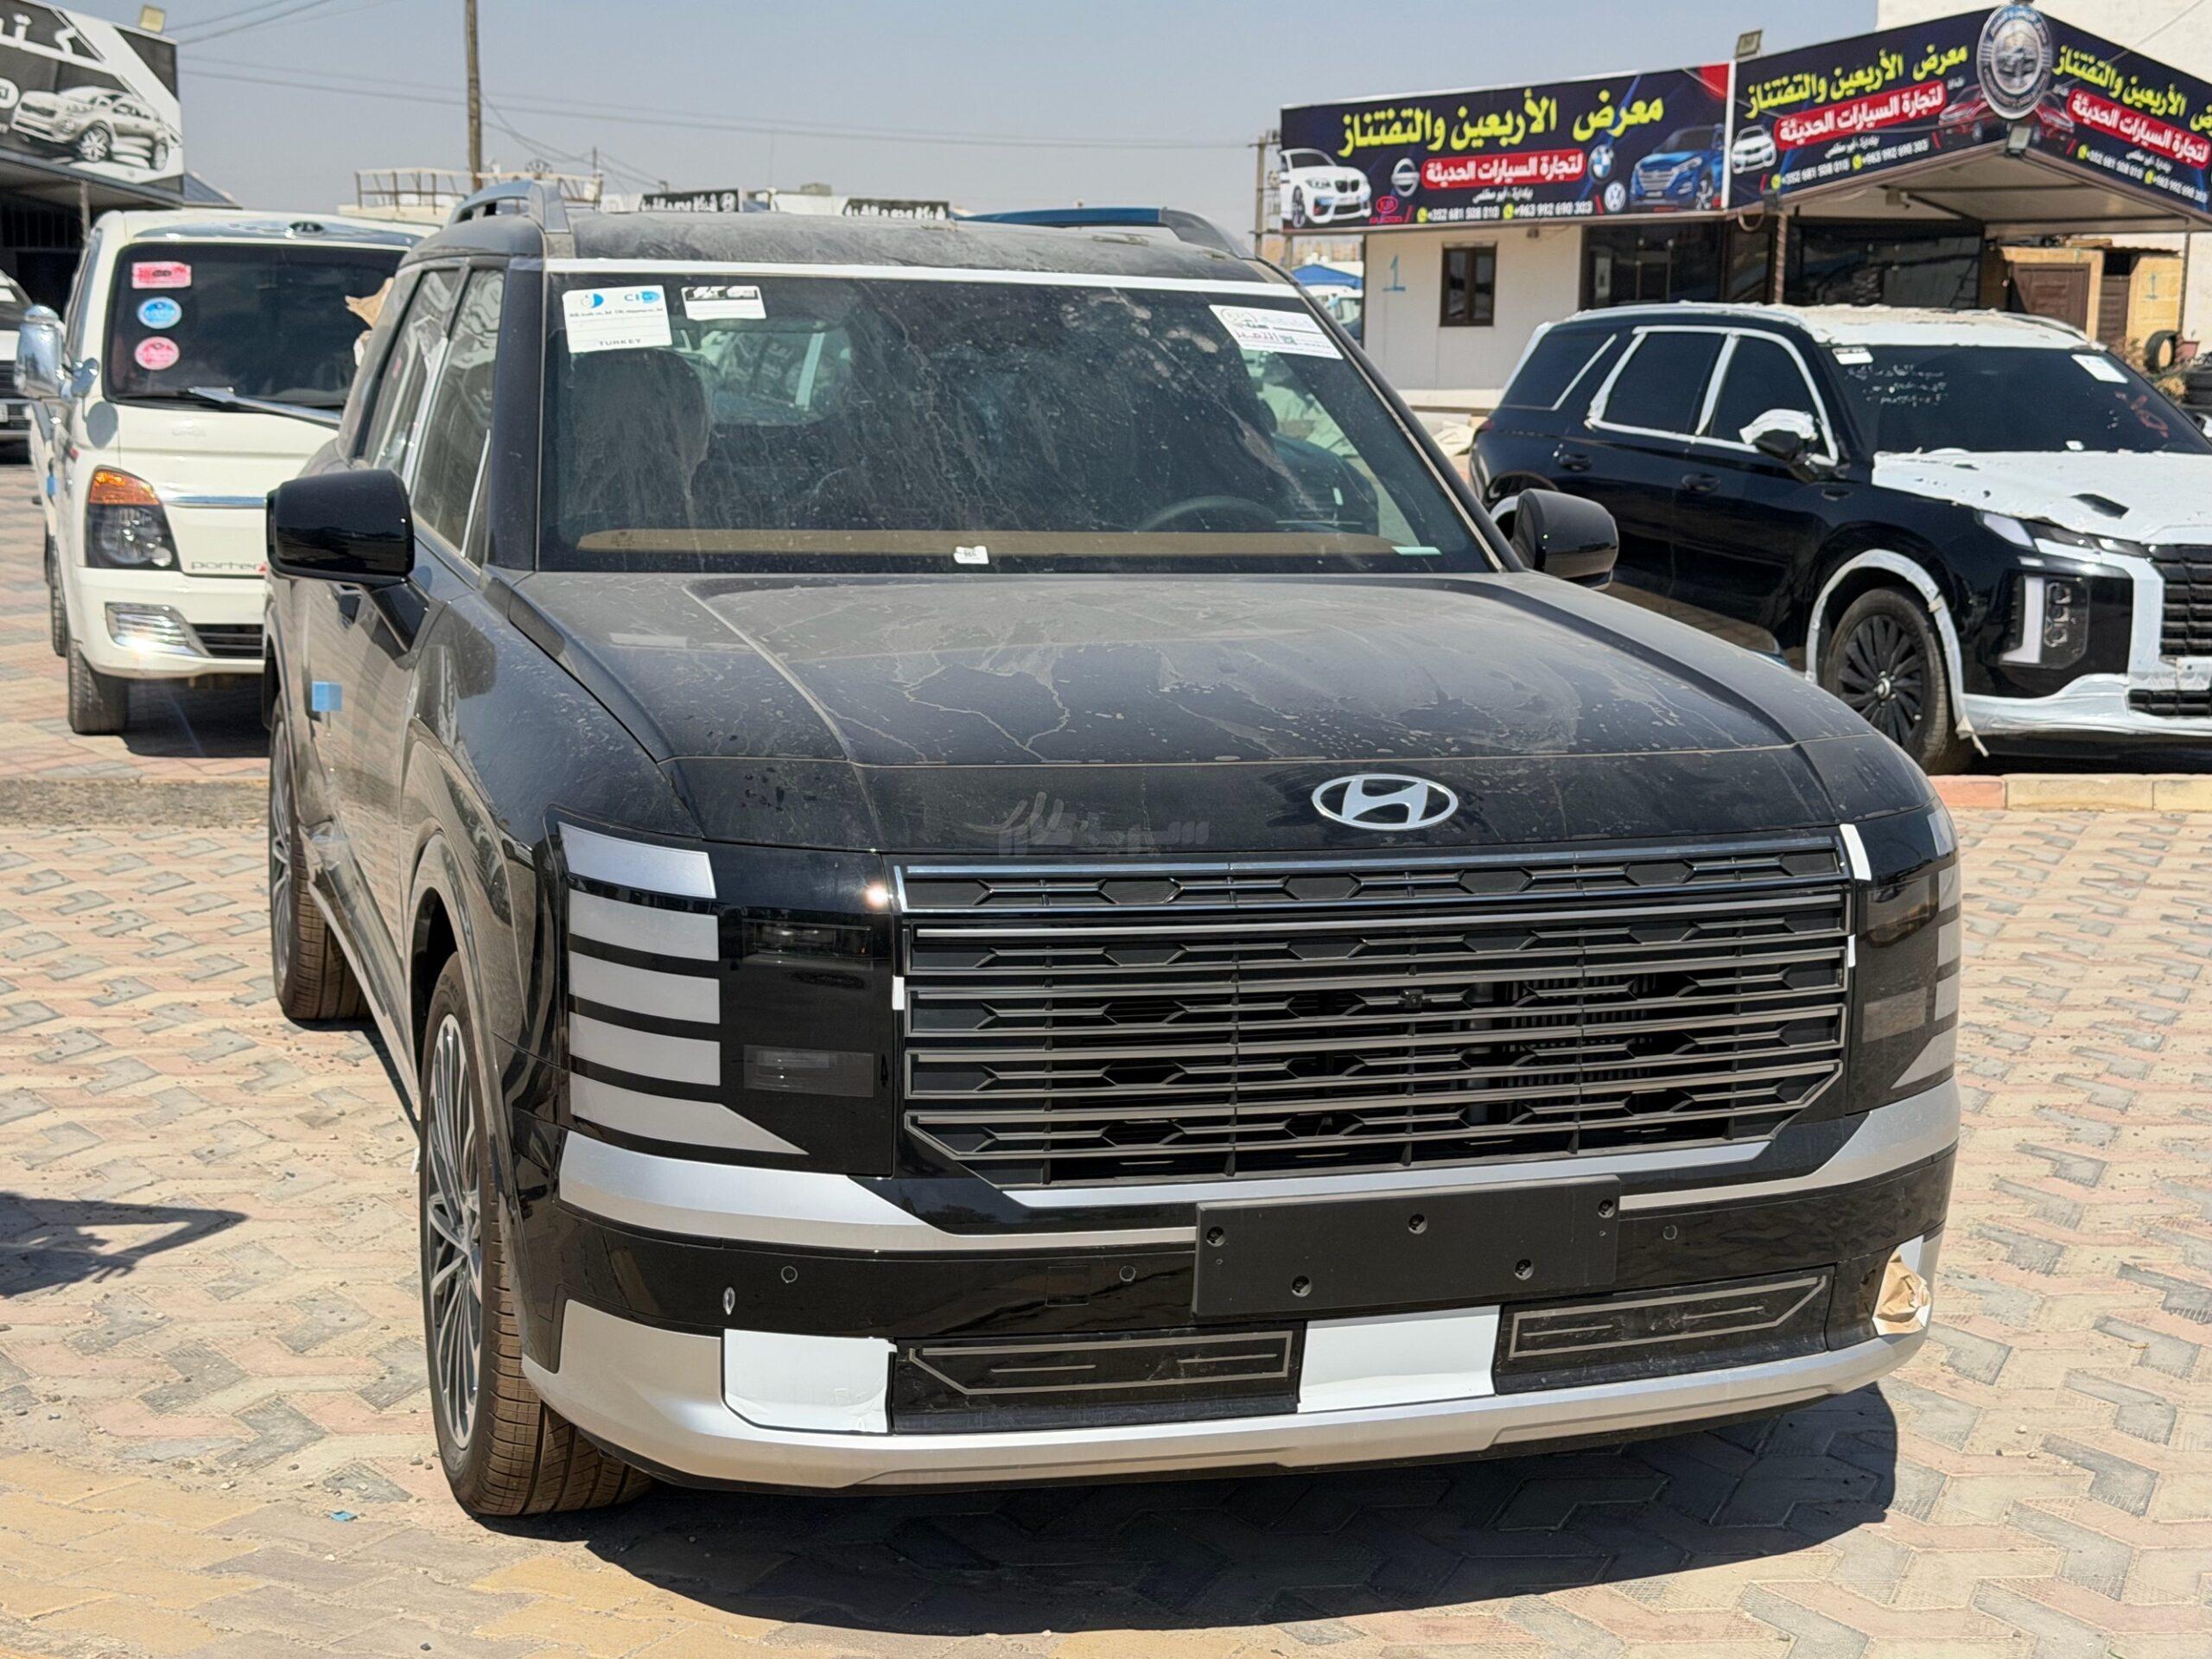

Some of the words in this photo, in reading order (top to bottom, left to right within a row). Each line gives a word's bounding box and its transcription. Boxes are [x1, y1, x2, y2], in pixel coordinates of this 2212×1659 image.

[1830, 48, 1904, 100] الأربعين
[1913, 44, 1968, 81] معرض
[2052, 45, 2124, 99] والتفتناز
[1745, 72, 1827, 119] والتفتناز
[1837, 93, 1900, 130] السيارات
[1902, 83, 1944, 118] لتجارة
[2071, 92, 2121, 129] الحديثة
[2122, 75, 2188, 117] الأربعين
[1337, 106, 1446, 158] والتفتناز
[1450, 87, 1557, 150] الأربعين
[1573, 89, 1664, 142] معرض
[1779, 110, 1836, 145] الحديثة
[2119, 116, 2173, 147] السيارات
[1540, 151, 1585, 181] لتجارة
[2171, 131, 2211, 164] لتجارة
[1426, 161, 1477, 188] الحديثة
[1478, 156, 1538, 184] السيارات
[599, 338, 642, 346] TURKEY
[191, 561, 257, 569] porter
